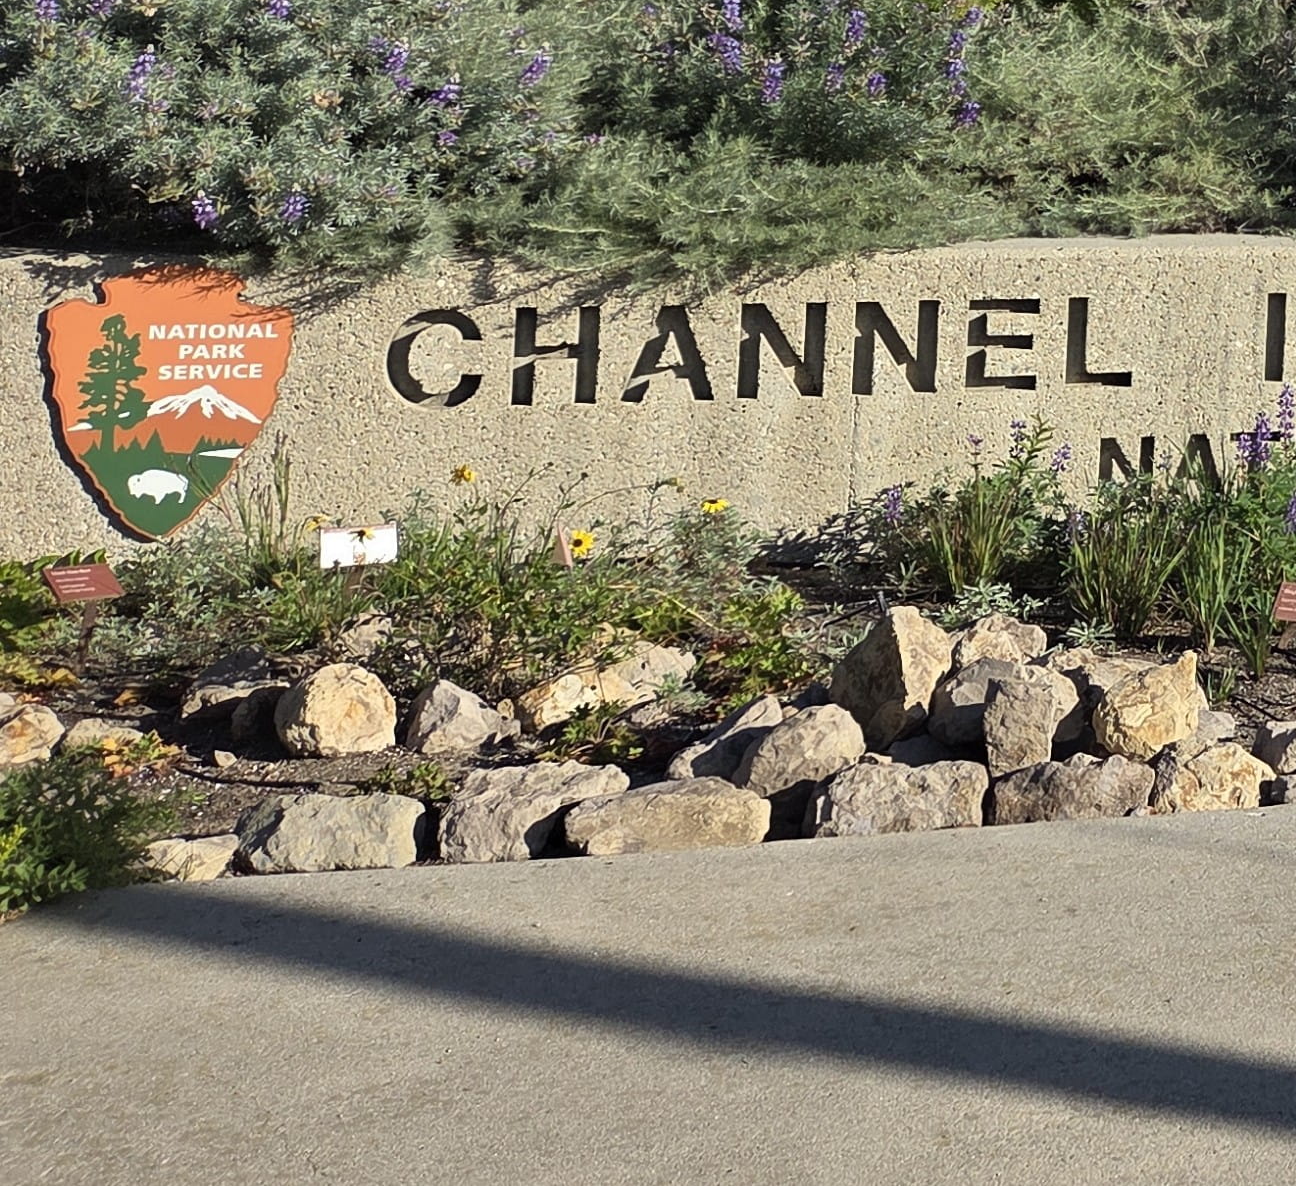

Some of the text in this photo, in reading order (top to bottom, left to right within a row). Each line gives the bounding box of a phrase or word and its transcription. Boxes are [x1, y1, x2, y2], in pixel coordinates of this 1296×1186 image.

[148, 323, 279, 340] NATIONAL
[178, 343, 246, 360] PARK
[385, 296, 1133, 408] CHANNEL
[158, 363, 263, 381] SERVICE
